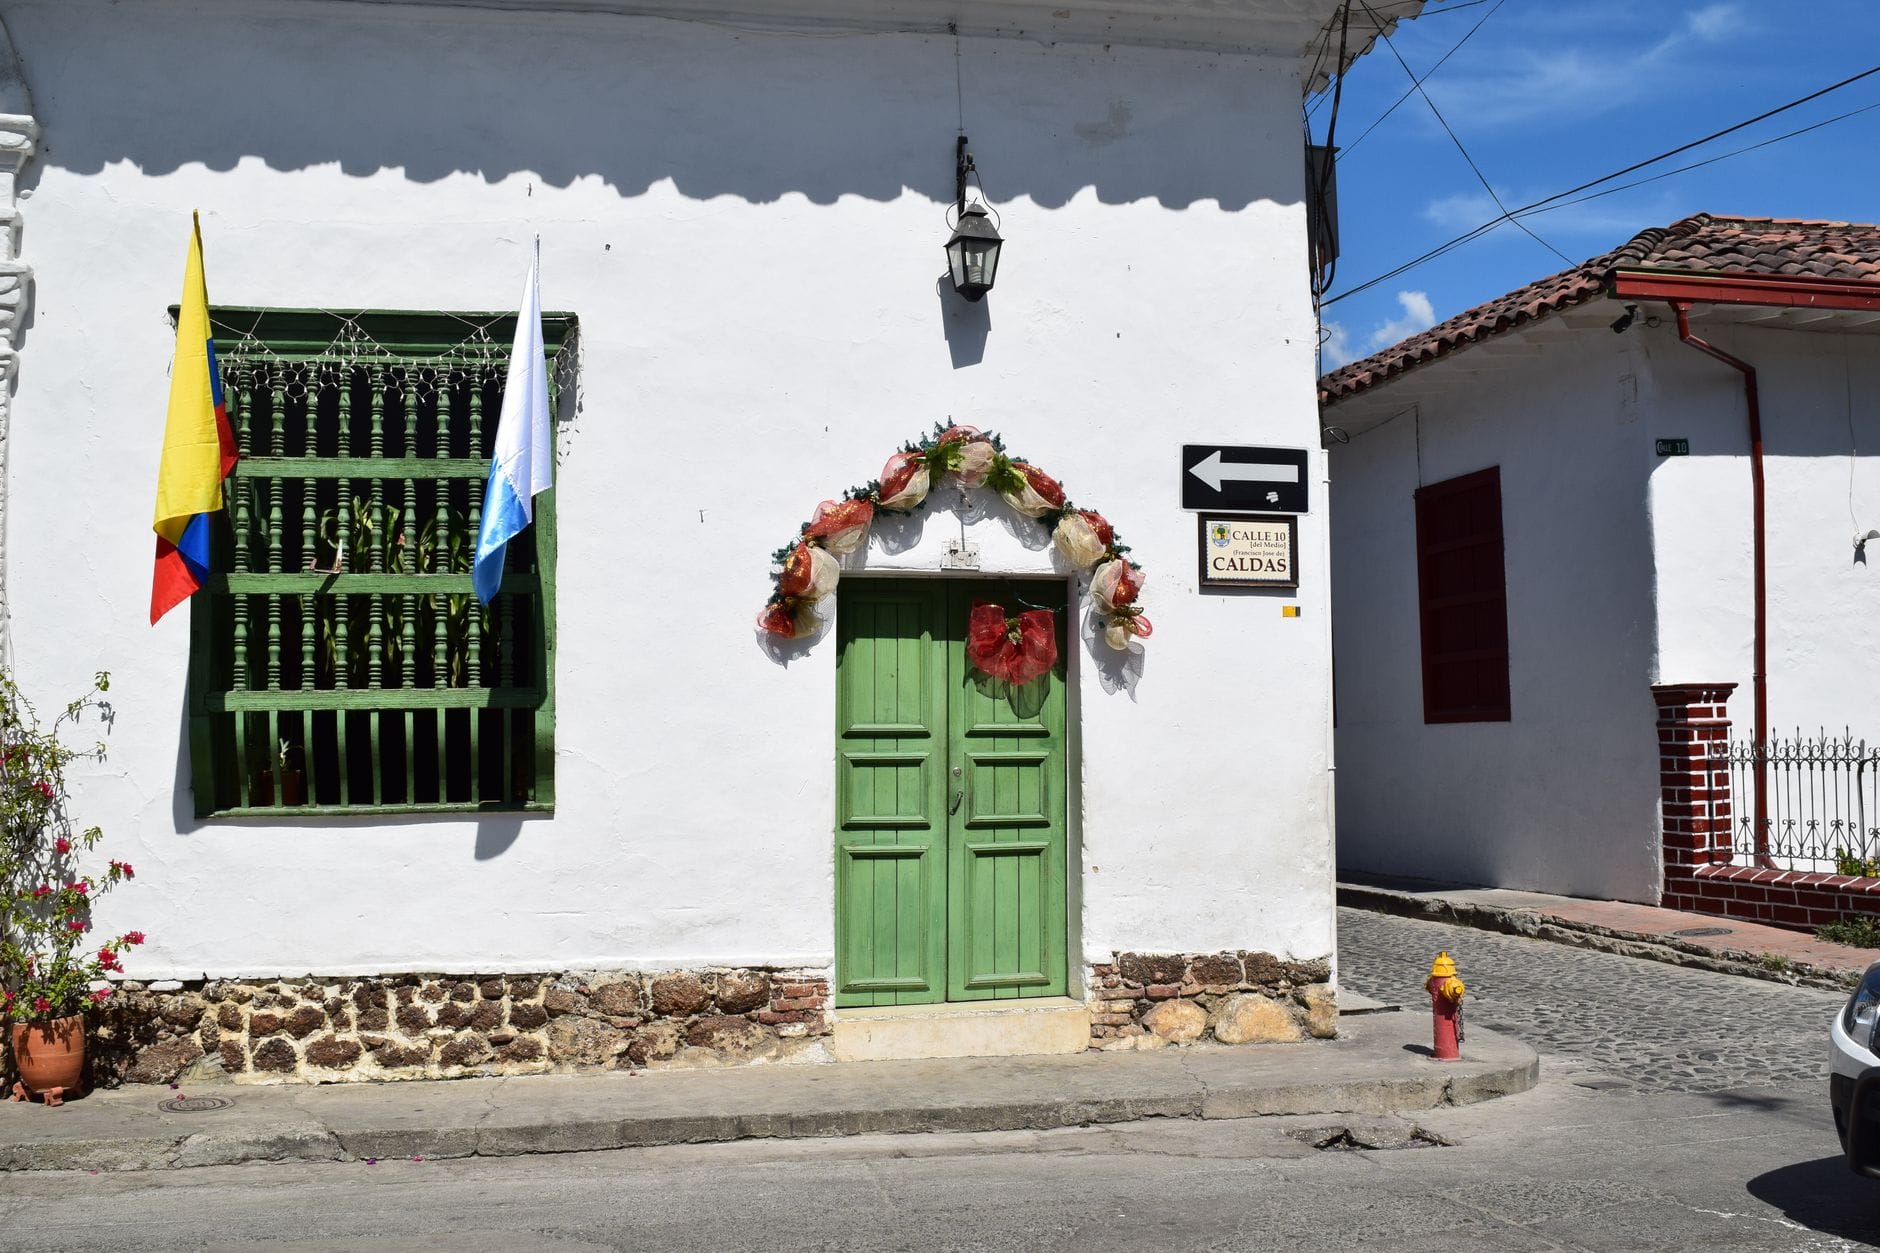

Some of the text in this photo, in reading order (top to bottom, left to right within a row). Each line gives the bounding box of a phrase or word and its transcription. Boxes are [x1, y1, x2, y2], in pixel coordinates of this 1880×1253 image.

[1676, 442, 1687, 453] 10
[1232, 530, 1286, 542] CALLE 10
[1213, 556, 1287, 573] CALDAS
